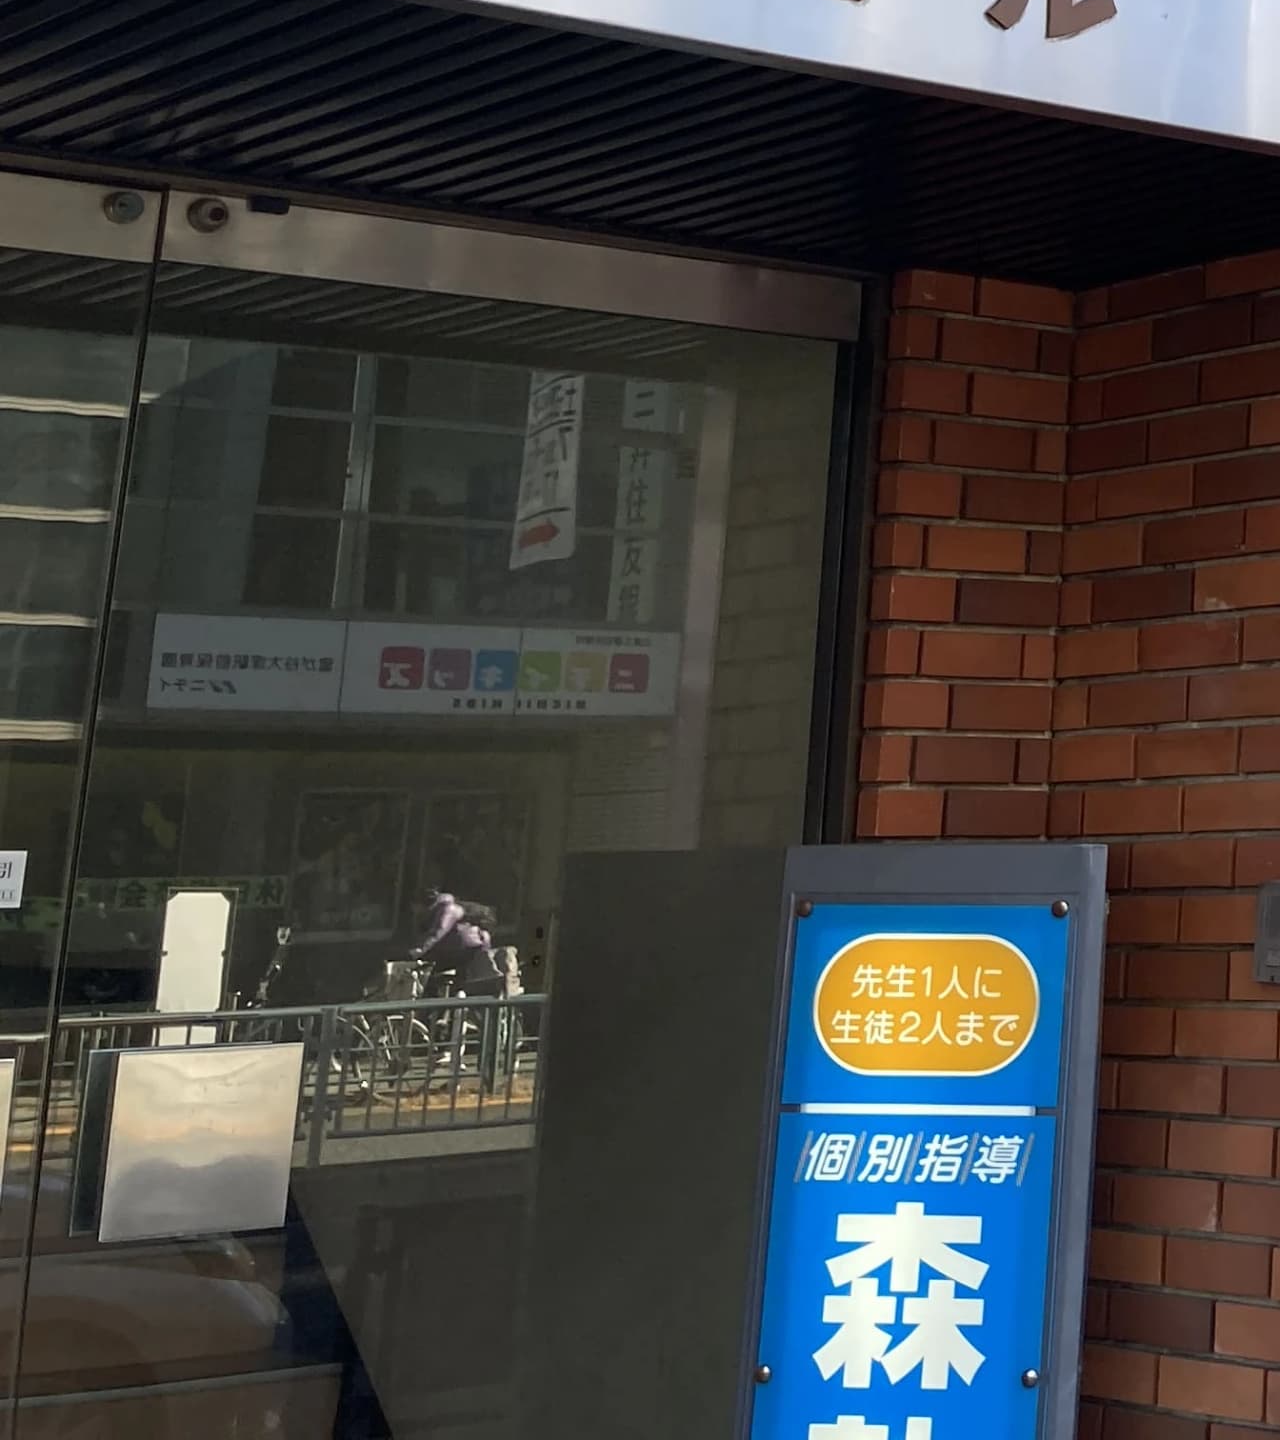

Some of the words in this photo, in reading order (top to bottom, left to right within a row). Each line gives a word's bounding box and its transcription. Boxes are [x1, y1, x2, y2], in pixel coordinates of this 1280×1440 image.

[850, 963, 1003, 1000] 先生1人に
[830, 1009, 1022, 1048] 生徒2人まで
[804, 1131, 1025, 1186] 個別指導
